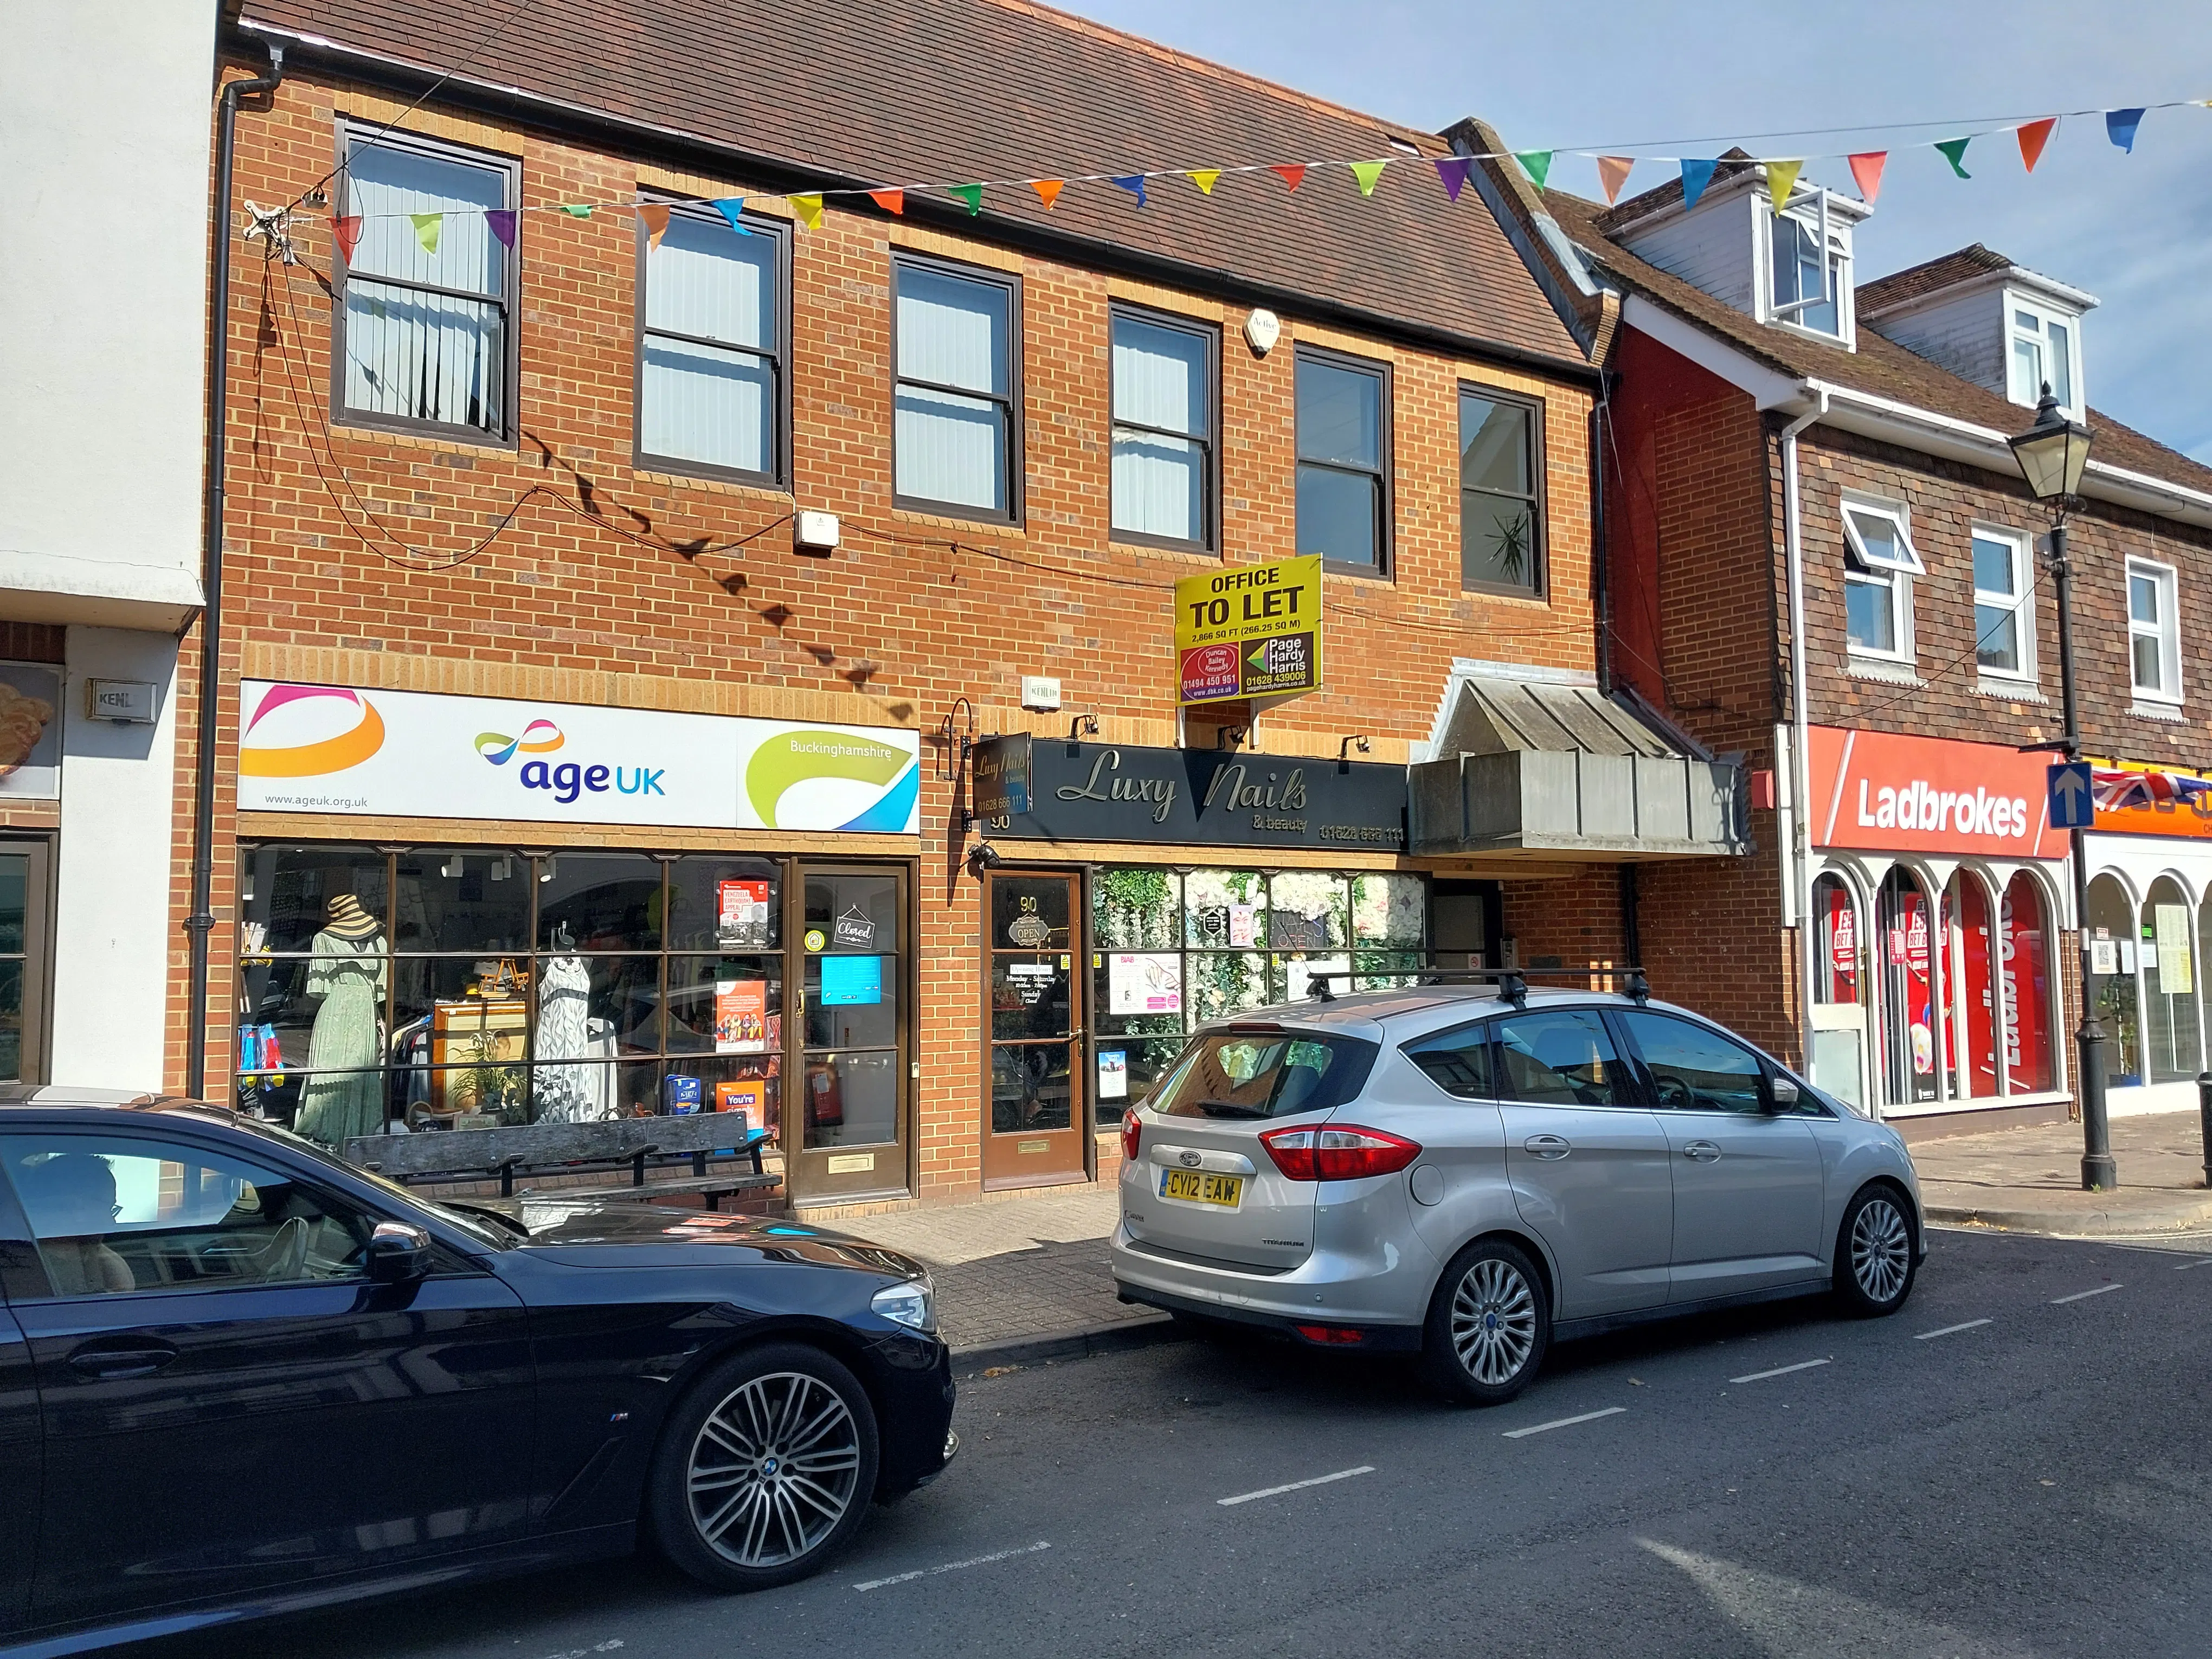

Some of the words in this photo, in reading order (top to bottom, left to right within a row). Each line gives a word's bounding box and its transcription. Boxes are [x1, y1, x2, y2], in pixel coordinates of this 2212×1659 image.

[1253, 317, 1276, 330] Active
[1211, 567, 1279, 593] OFFICE
[1189, 599, 1229, 629] TO
[1243, 586, 1304, 621] LET
[1192, 633, 1213, 643] 2,866
[1229, 628, 1238, 636] FT
[1241, 625, 1272, 637] (266.25
[1275, 622, 1287, 630] SQ
[1290, 619, 1300, 629] M)
[1269, 639, 1302, 653] Page
[1205, 650, 1227, 659] Duncan
[1208, 657, 1225, 666] Bailey
[1269, 648, 1305, 664] Hardy
[1205, 663, 1229, 673] Kennedy
[1269, 661, 1306, 674] Harris
[1184, 678, 1204, 690] 01494
[1206, 676, 1220, 686] 450
[1246, 675, 1272, 686] 01628
[1274, 671, 1306, 683] 439006
[1032, 687, 1057, 698] KENLIN
[1193, 686, 1232, 697] www.dbk.co.uk
[790, 740, 892, 761] Buckinghamshire
[974, 755, 999, 782] Luxy
[1000, 750, 1025, 773] Nails
[520, 761, 610, 804] age
[616, 767, 666, 796] UK
[1056, 750, 1176, 824] Luxy
[1203, 763, 1308, 812] Nails
[265, 793, 368, 808] www.ageuk.org.uk
[978, 799, 997, 813] 01628
[998, 796, 1011, 809] 666
[1012, 794, 1023, 806] 111
[1857, 777, 2027, 840] Ladbrokes
[1253, 815, 1263, 828] &
[1266, 815, 1308, 833] beauty
[1320, 825, 1357, 840] 01628
[1385, 828, 1404, 841] 111
[1020, 896, 1037, 912] 90
[838, 922, 871, 939] Closed
[1018, 928, 1040, 938] OPEN
[1836, 933, 1848, 947] BET
[1909, 933, 1921, 946] BET
[1006, 975, 1028, 984] Monday
[1033, 975, 1056, 985] Saturday
[1021, 991, 1041, 999] Sunday
[728, 1095, 754, 1104] You're
[1170, 1173, 1200, 1197] CY12
